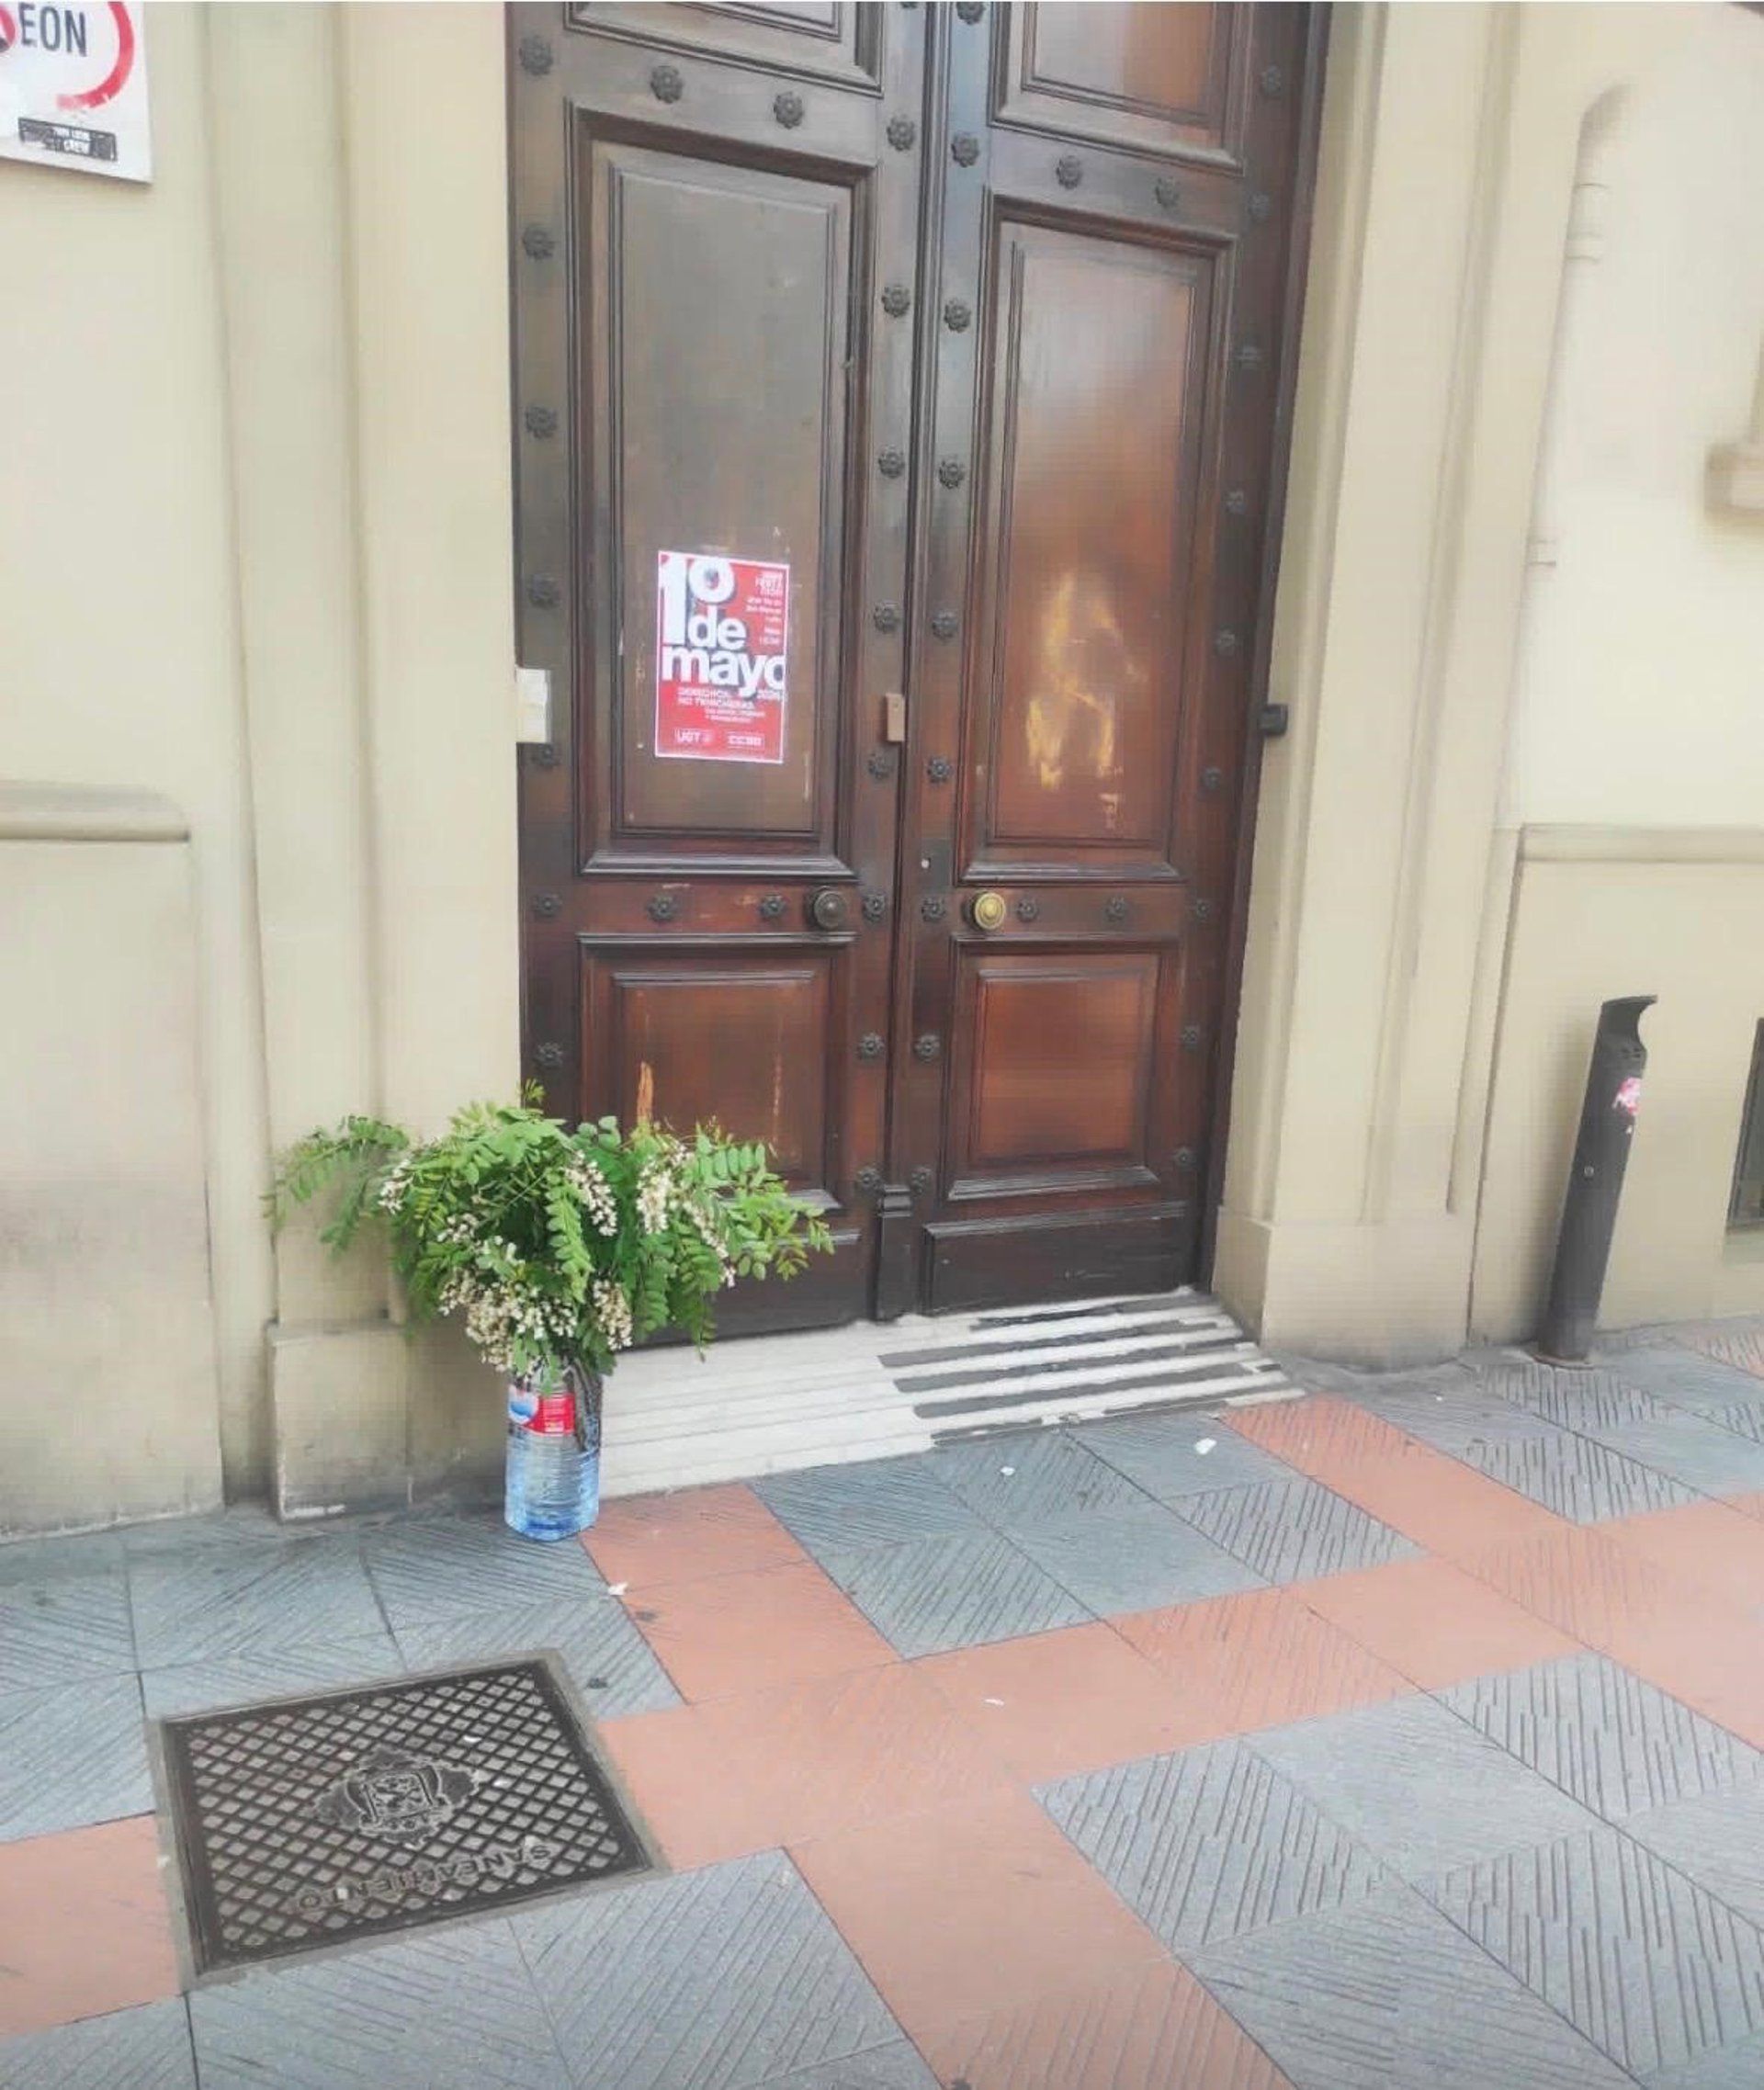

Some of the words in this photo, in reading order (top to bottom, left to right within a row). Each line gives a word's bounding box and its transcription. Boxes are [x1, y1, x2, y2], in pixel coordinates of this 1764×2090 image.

[688, 605, 747, 650] de
[662, 646, 786, 698] mayo
[677, 730, 701, 743] UGT
